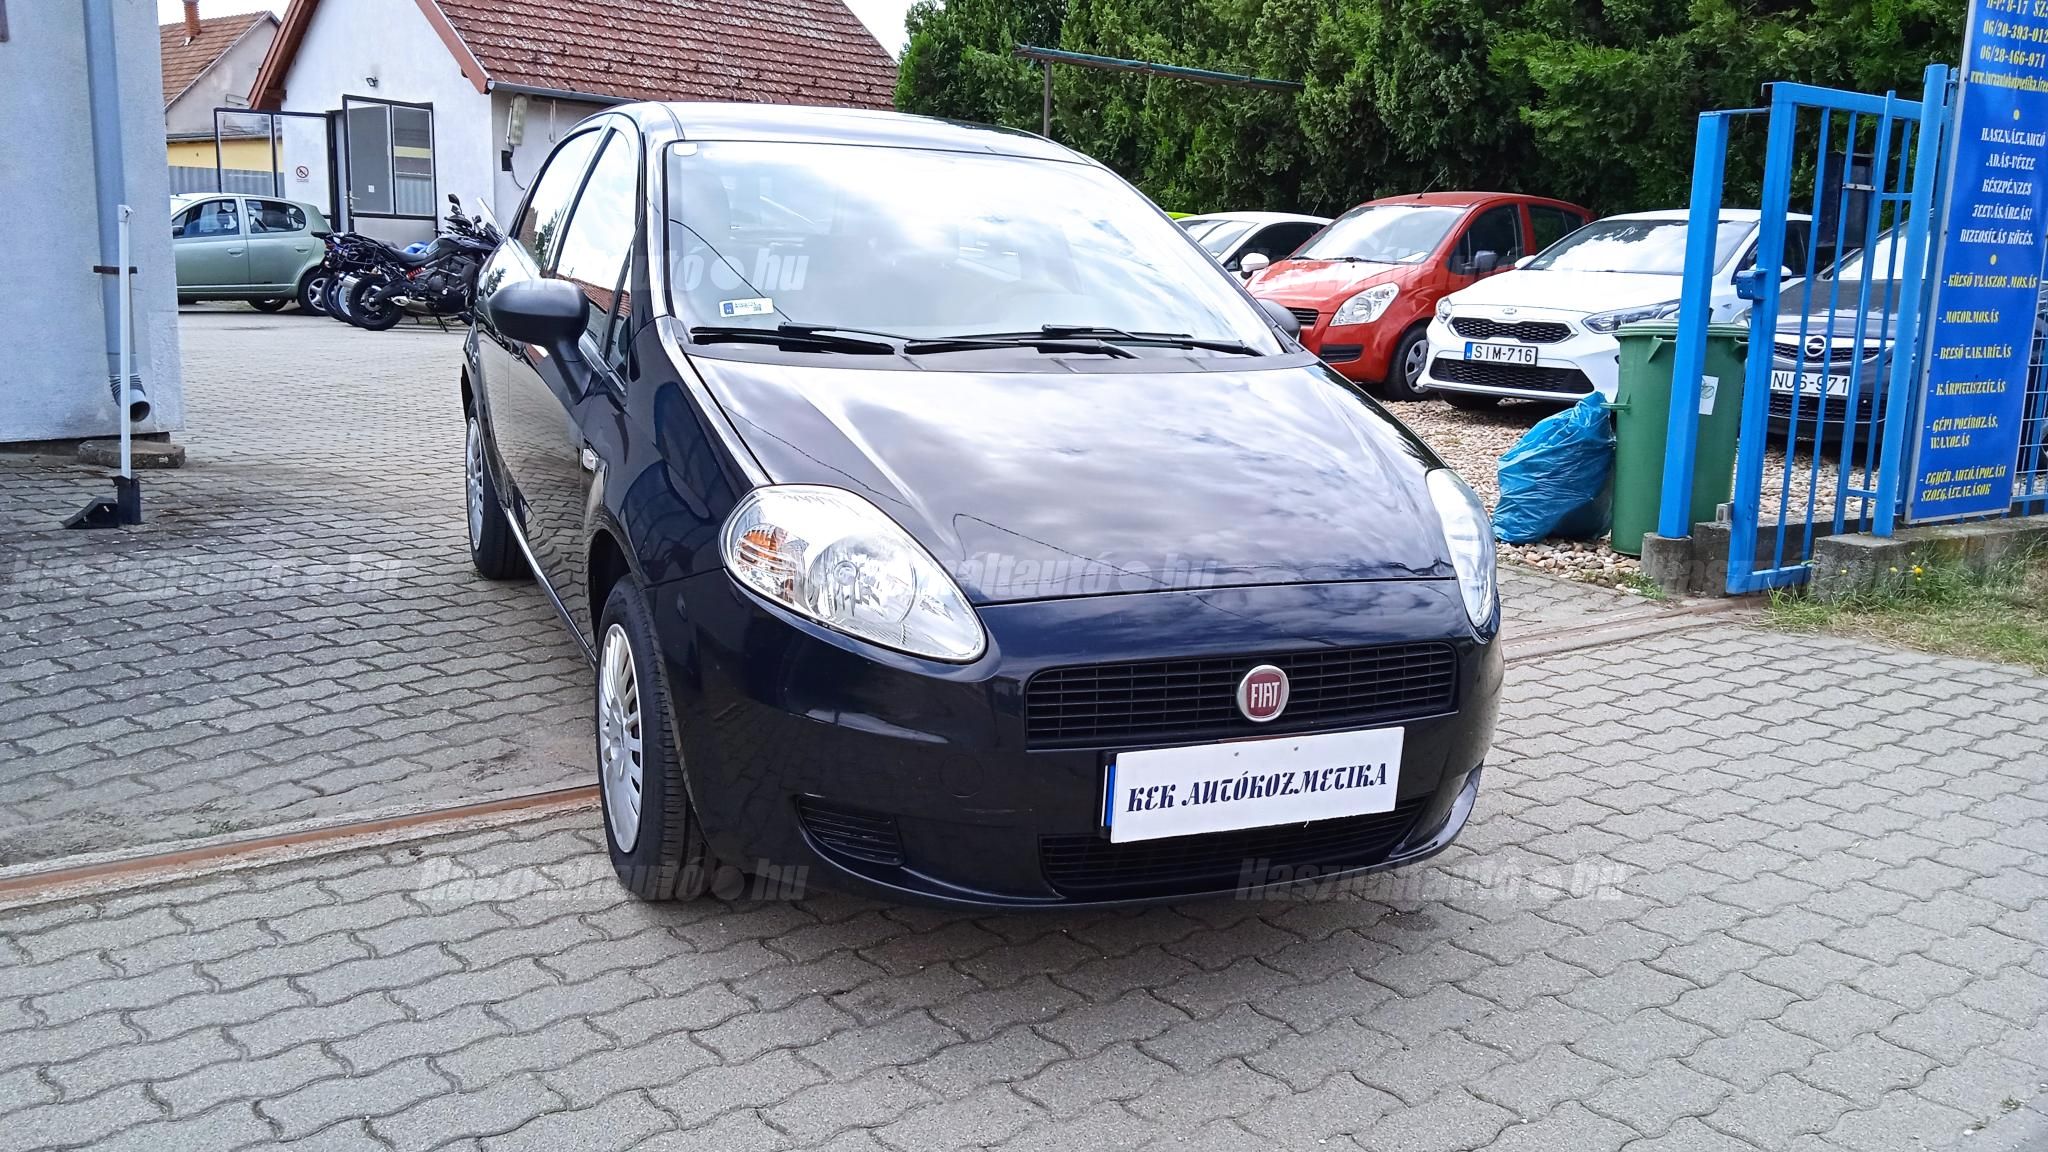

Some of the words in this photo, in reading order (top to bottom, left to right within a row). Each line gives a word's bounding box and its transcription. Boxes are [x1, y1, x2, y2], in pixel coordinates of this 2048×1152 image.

[1986, 152, 2036, 171] ADÁS-VÉTEL
[1982, 176, 2032, 195] KÉSZPÉNZES
[1474, 345, 1533, 362] SIM-716
[1965, 344, 2012, 358] TAKARÍTÁS
[1251, 681, 1280, 708] FIAT
[1126, 784, 1176, 812] KEK
[1182, 763, 1387, 807] AUTÓKOZMETIKA
